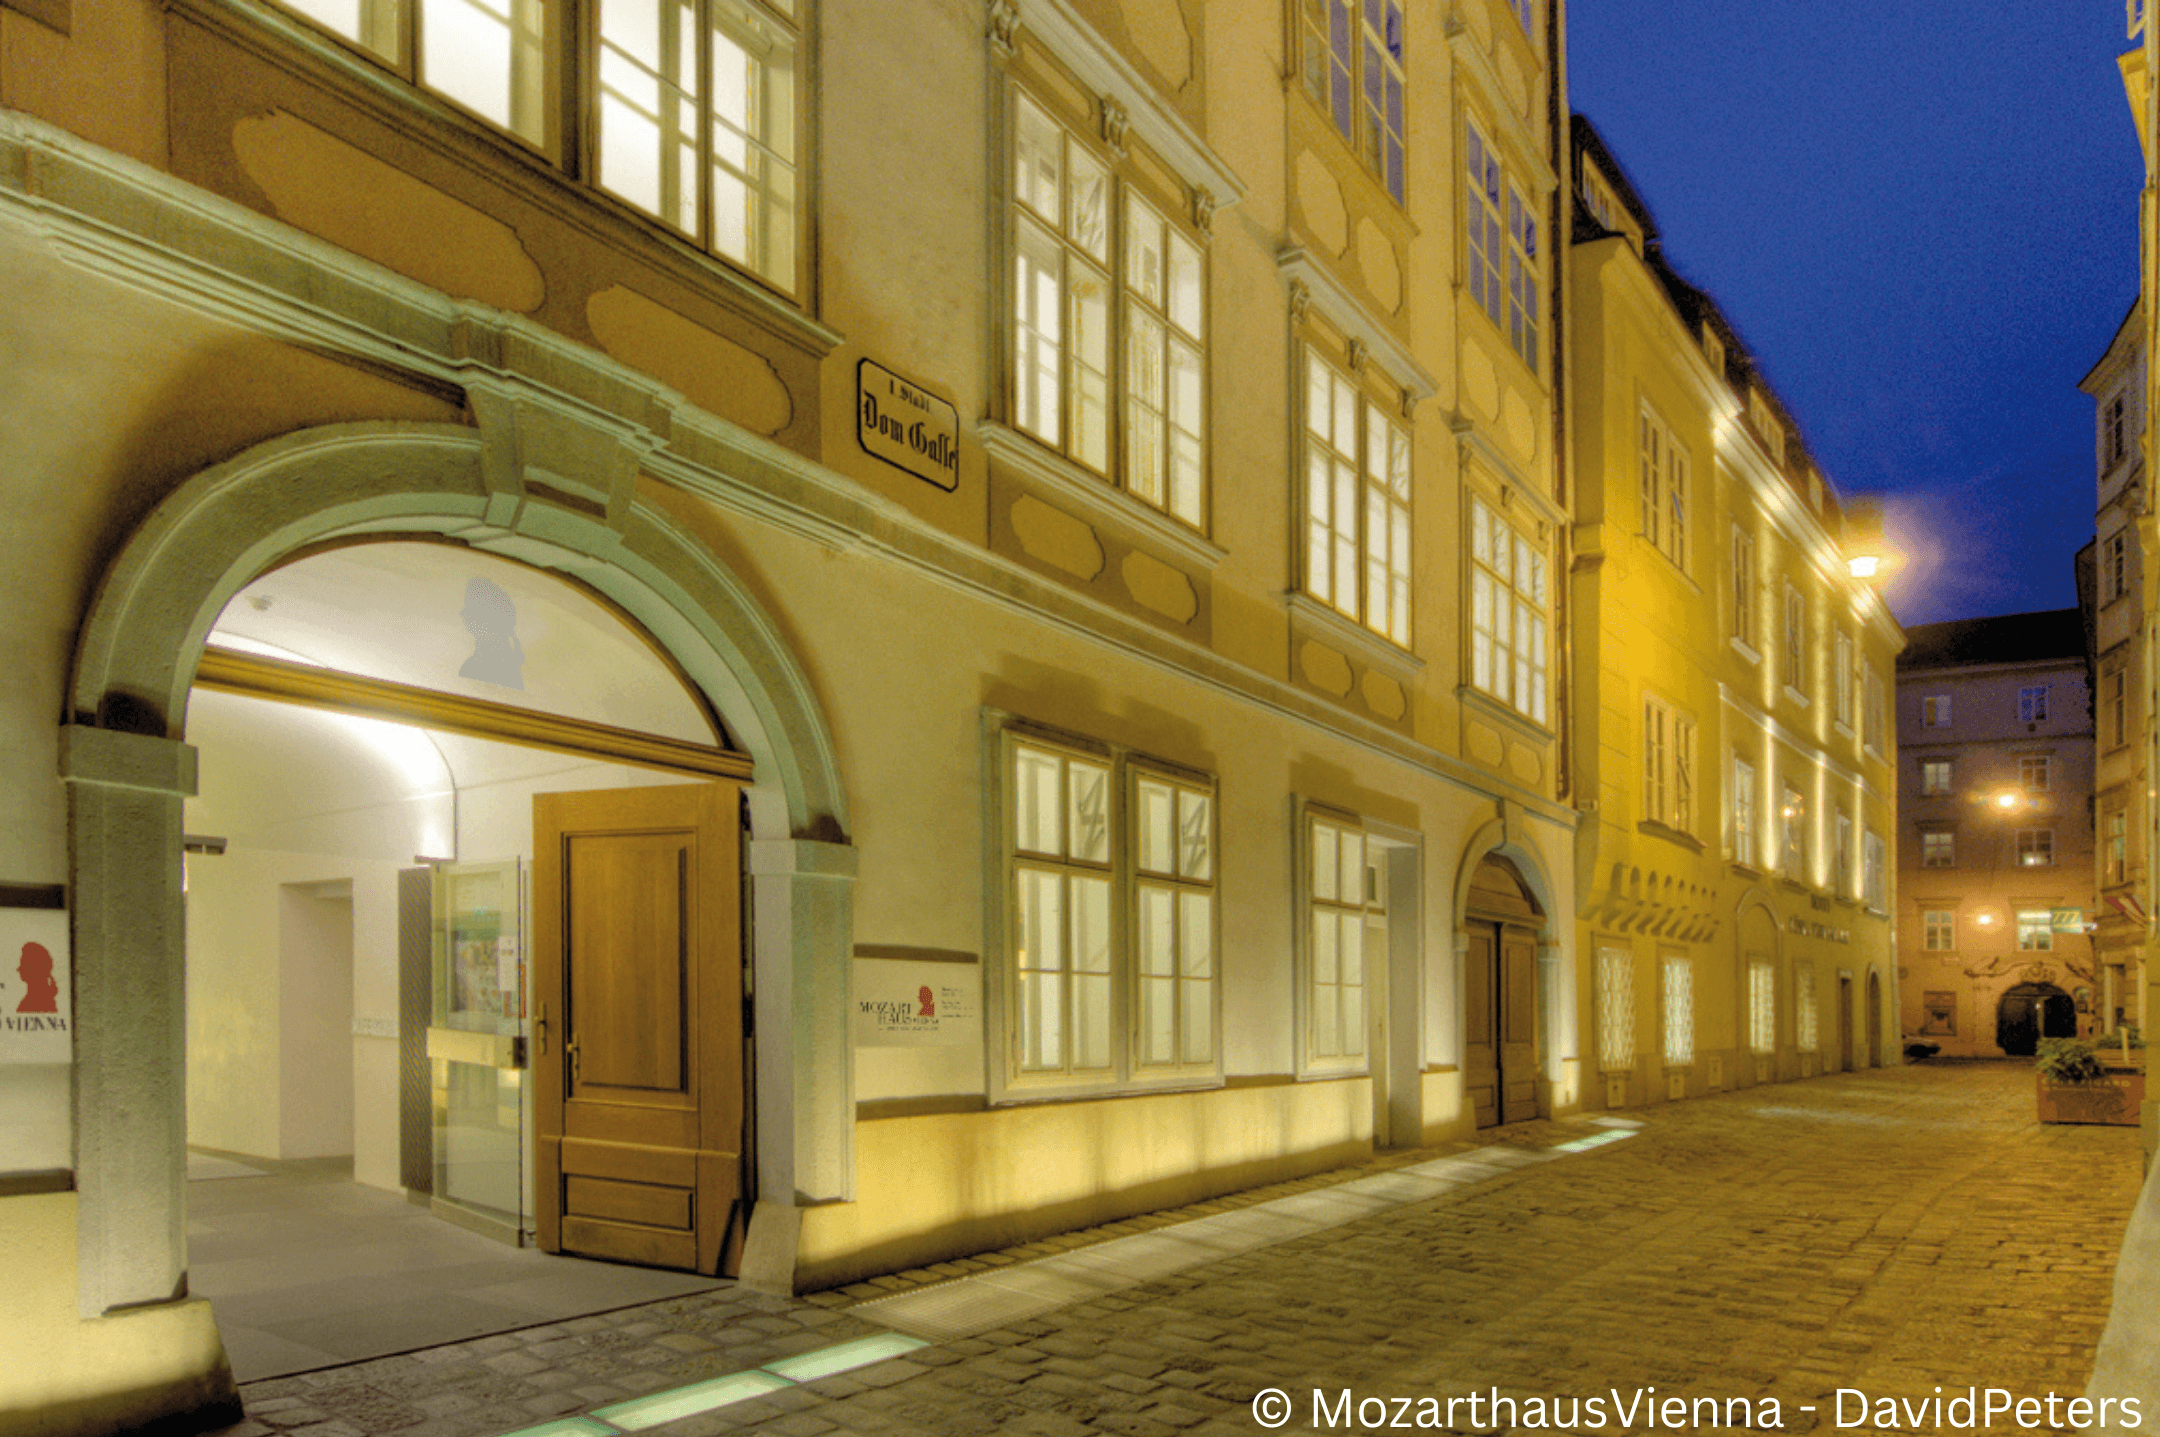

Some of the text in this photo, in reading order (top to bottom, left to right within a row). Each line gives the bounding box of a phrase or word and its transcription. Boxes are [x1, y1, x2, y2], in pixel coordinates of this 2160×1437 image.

[864, 389, 904, 444] Dom
[860, 1001, 911, 1014] MOZART
[6, 1016, 67, 1032] VIENNA
